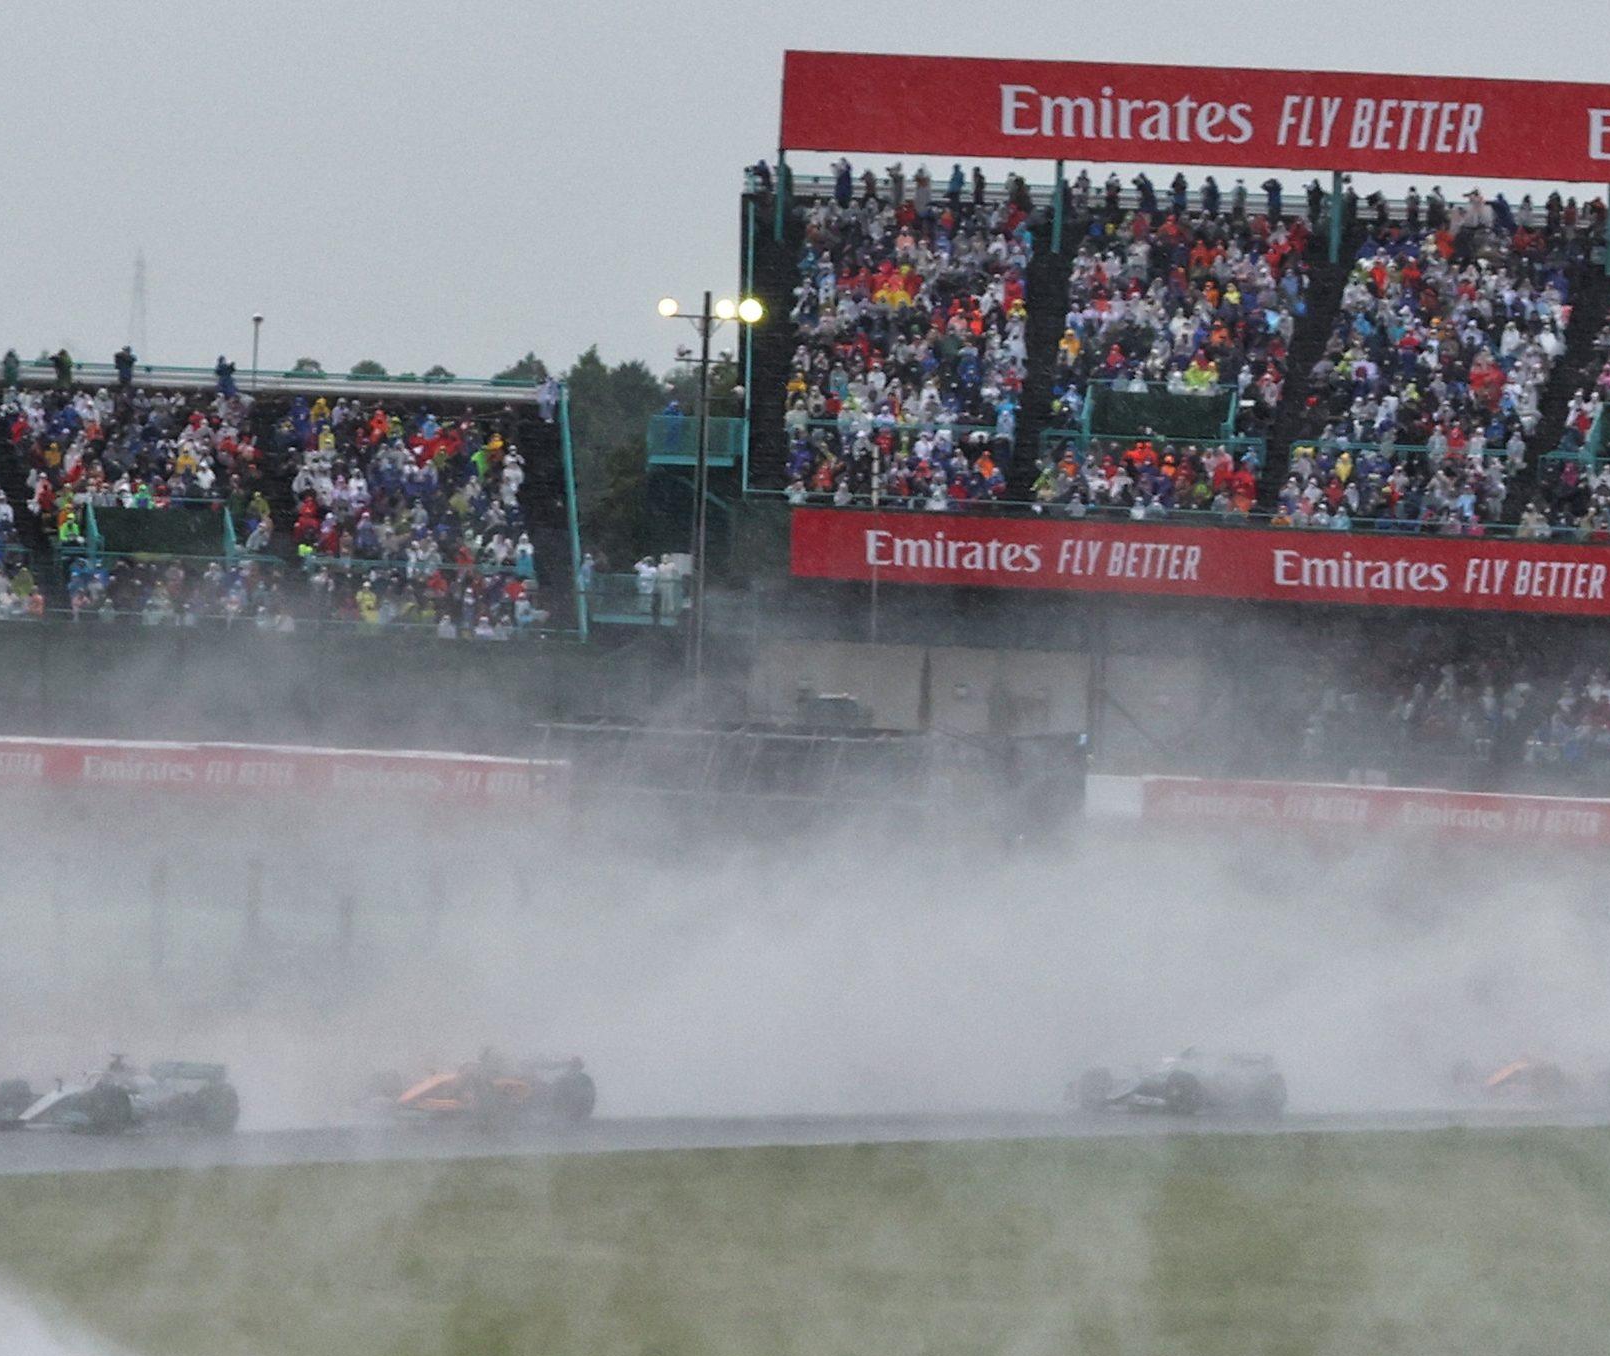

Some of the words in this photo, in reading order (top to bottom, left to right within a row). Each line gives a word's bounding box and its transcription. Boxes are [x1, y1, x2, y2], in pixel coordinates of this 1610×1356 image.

[1000, 84, 1253, 144] Emirates
[1277, 95, 1343, 148] FLY
[1349, 98, 1483, 154] BETTER
[866, 530, 1042, 573] Emirates
[1057, 539, 1102, 576] FLY
[1106, 541, 1202, 581] BETTER
[1273, 549, 1449, 592] Emirates
[1464, 558, 1509, 595] FLY
[1513, 560, 1607, 600] BETTER
